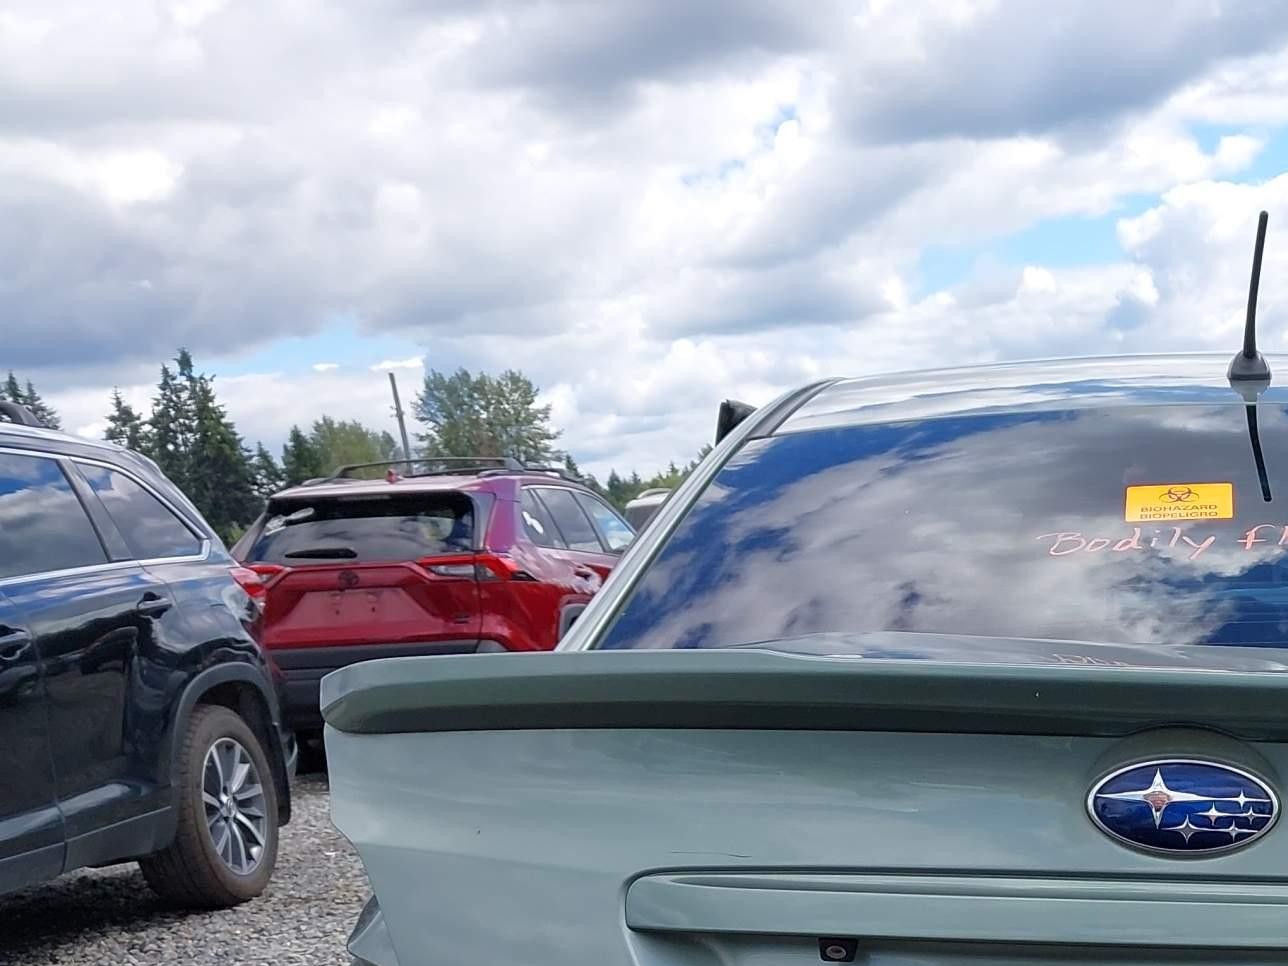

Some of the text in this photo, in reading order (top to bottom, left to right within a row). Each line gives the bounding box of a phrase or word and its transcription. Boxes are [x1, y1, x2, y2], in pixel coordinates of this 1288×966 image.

[1141, 504, 1218, 512] BIOHAZARD
[1140, 511, 1218, 519] BIOPELIGRO
[1036, 526, 1216, 560] Bodily
